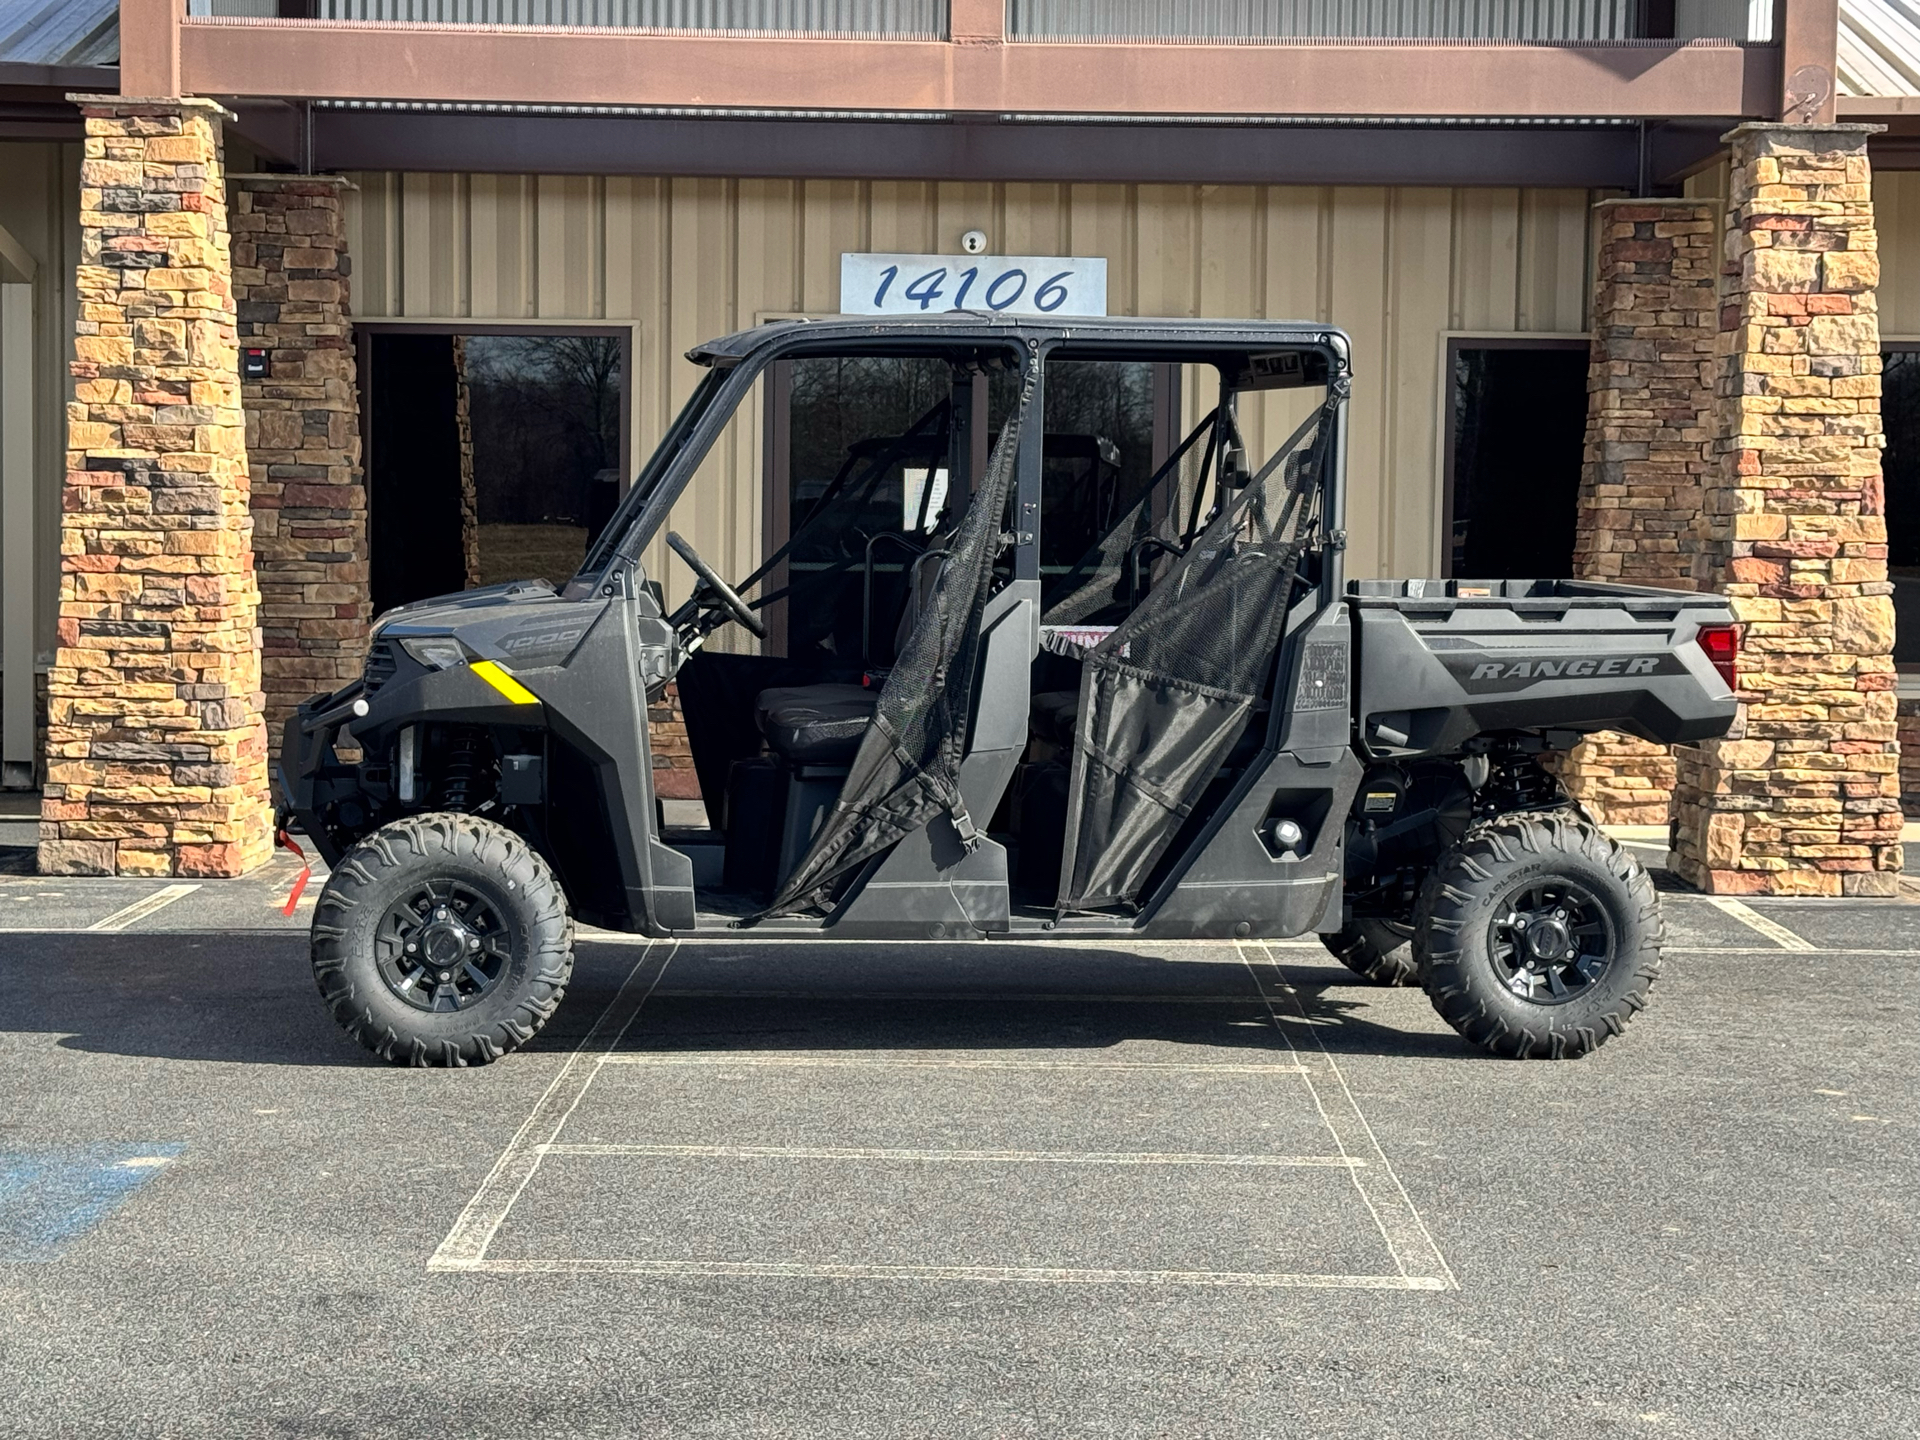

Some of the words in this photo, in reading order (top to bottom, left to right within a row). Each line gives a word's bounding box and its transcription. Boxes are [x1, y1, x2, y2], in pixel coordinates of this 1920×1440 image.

[873, 265, 1075, 312] 14106
[504, 630, 581, 649] 1000
[1470, 657, 1661, 680] RANGER
[1482, 863, 1541, 907] CARLSTAR
